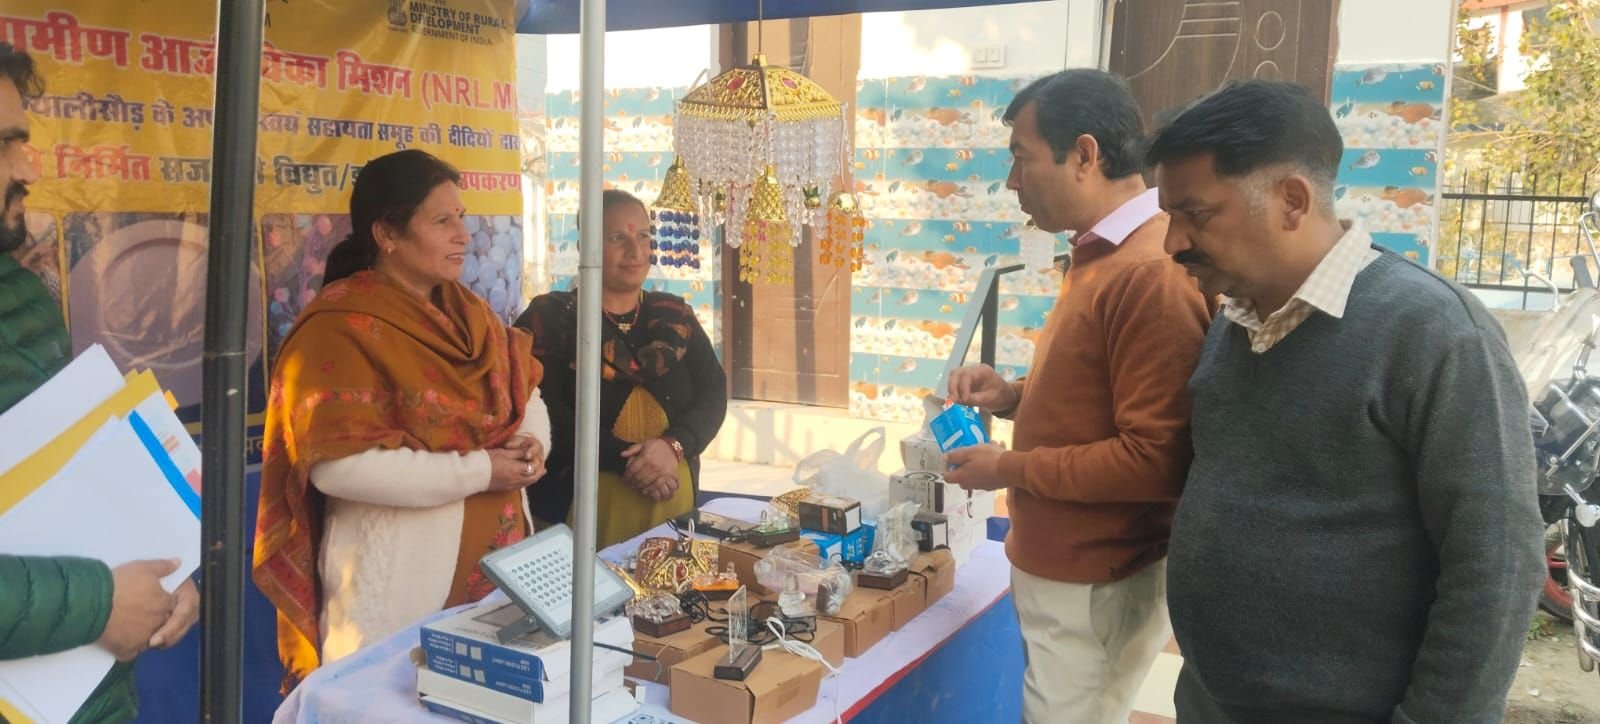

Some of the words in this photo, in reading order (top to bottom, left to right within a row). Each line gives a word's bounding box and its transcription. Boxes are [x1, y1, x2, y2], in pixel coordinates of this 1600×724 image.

[410, 1, 456, 20] MINISTRY
[459, 11, 471, 23] OF
[474, 14, 507, 29] RURAL
[337, 51, 412, 98] मिशन
[153, 98, 175, 126] के
[307, 117, 374, 140] सहायता
[378, 123, 414, 150] समूह
[419, 123, 442, 144] की
[448, 124, 494, 148] दीदियों
[55, 144, 150, 180] निर्मित
